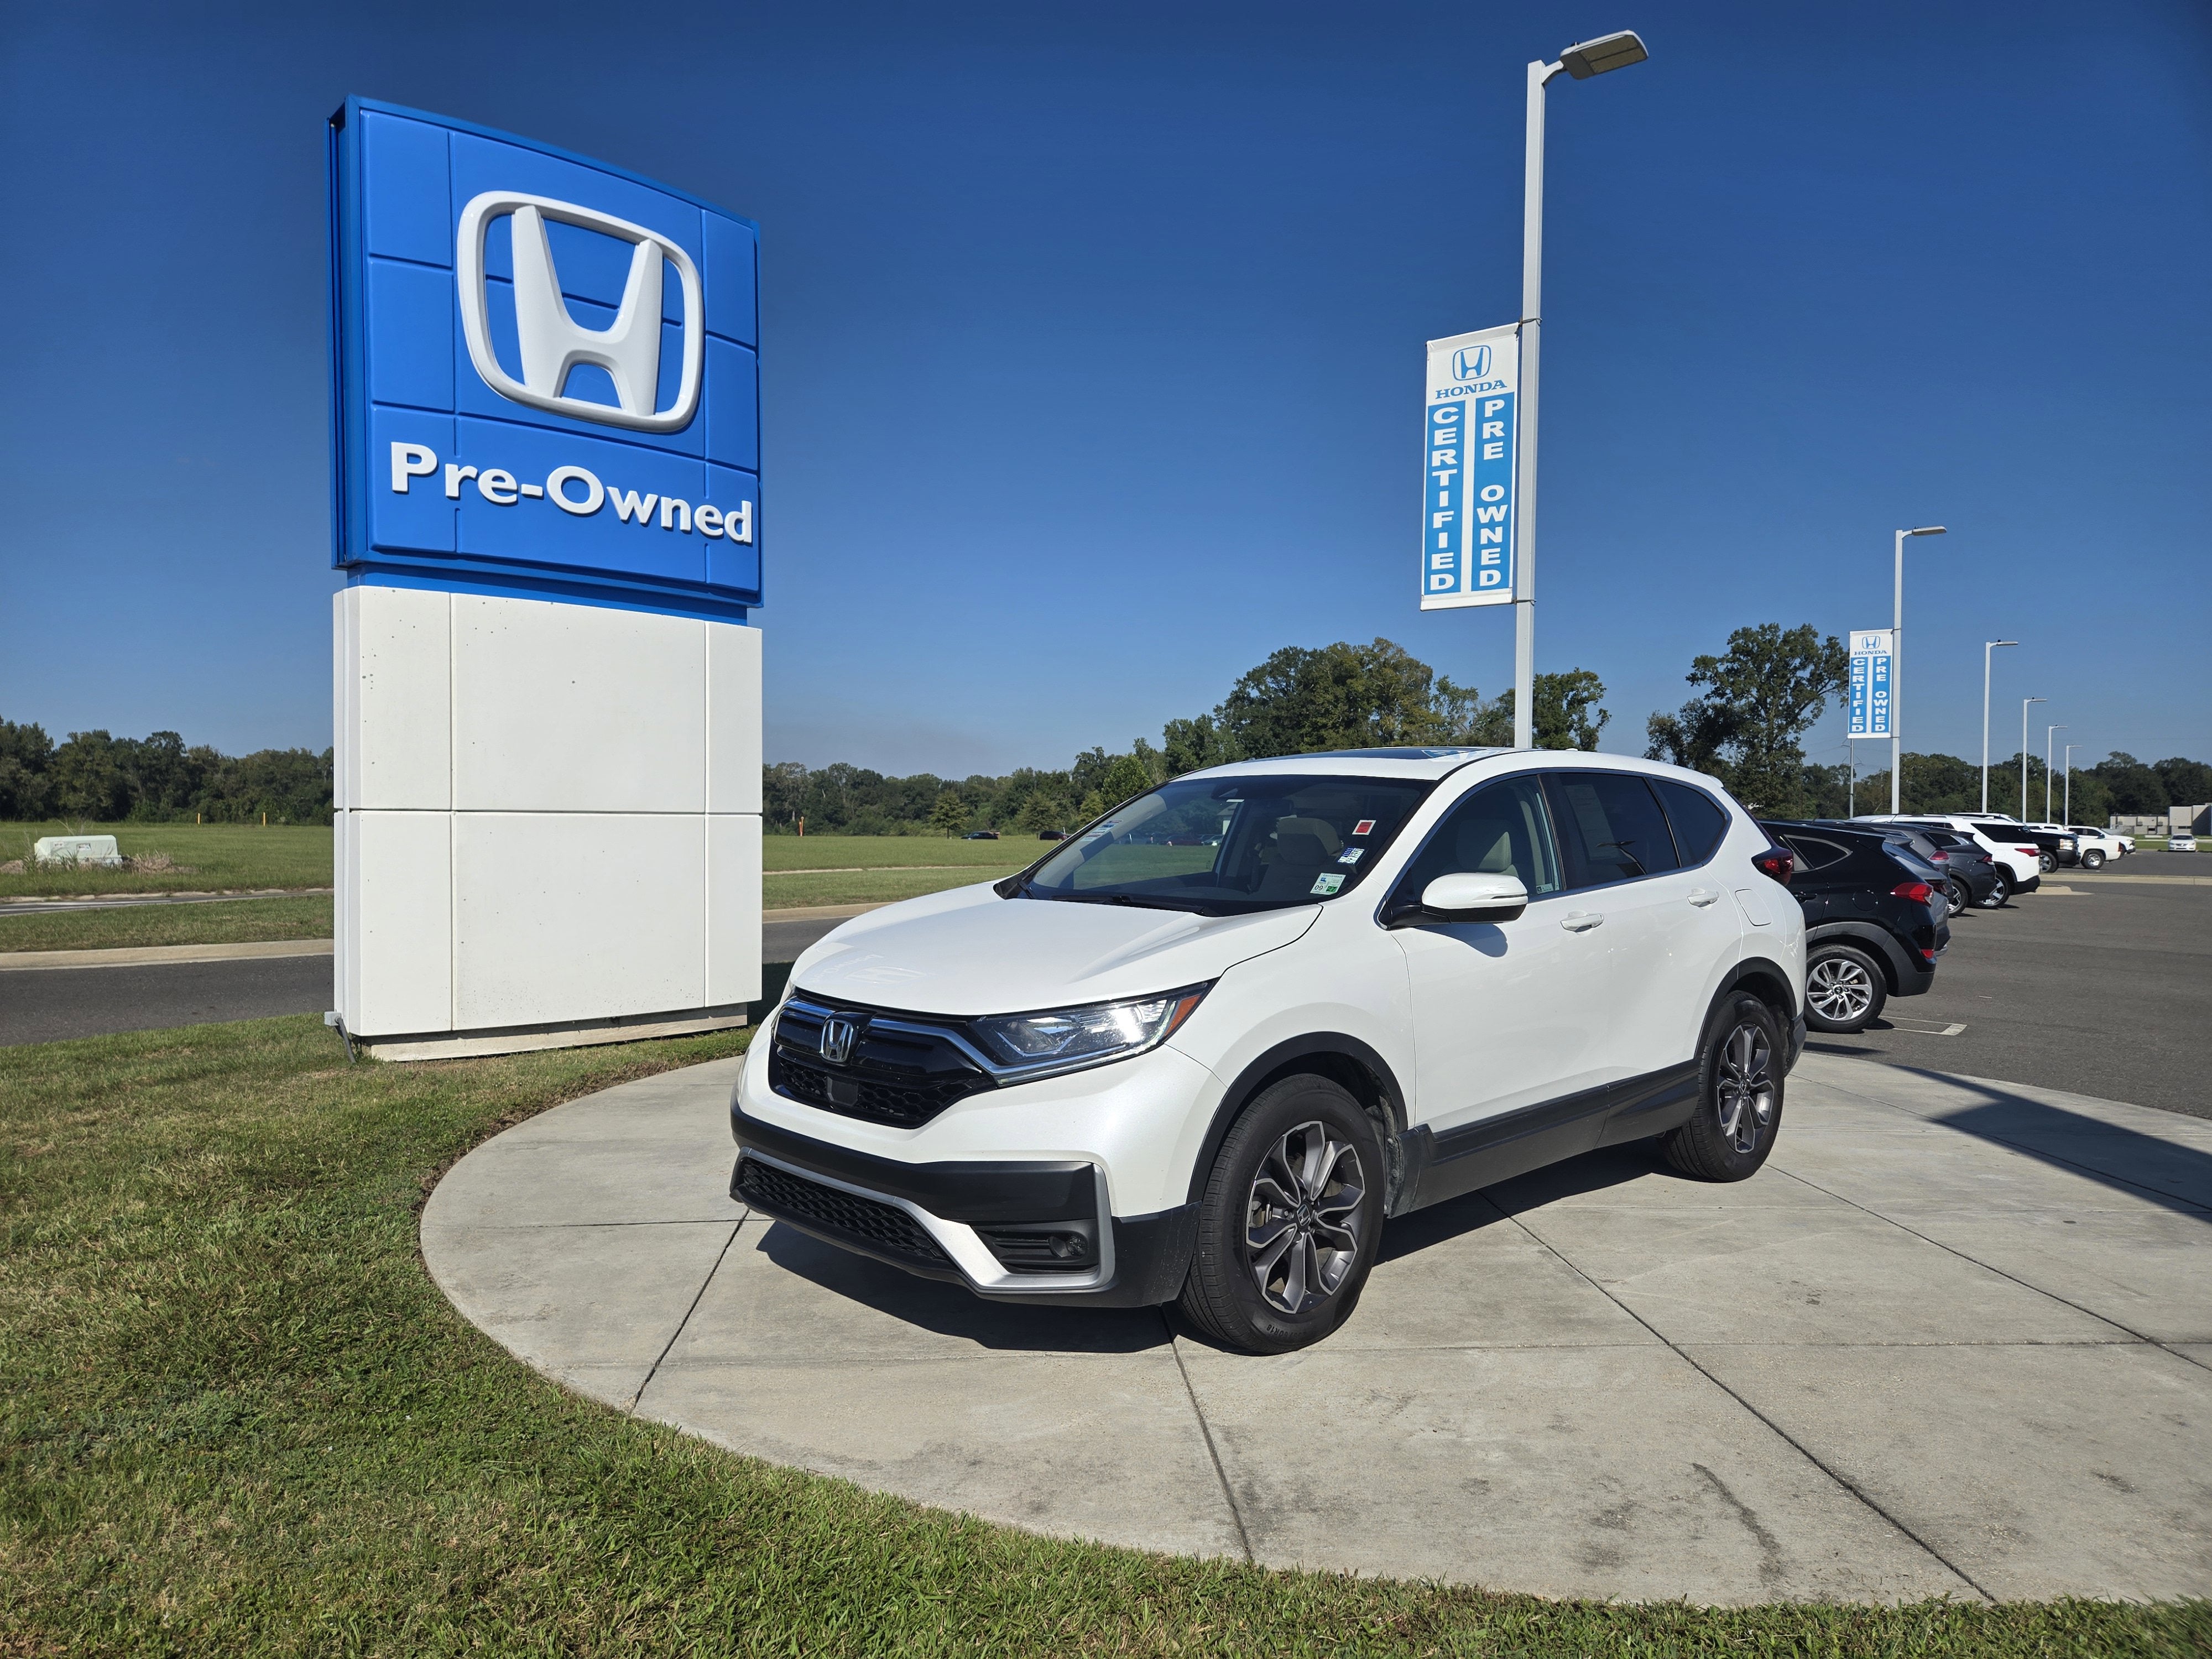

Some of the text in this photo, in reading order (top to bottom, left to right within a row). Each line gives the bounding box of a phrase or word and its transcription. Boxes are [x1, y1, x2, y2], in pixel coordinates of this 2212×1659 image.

[1435, 379, 1507, 399] HONDA
[390, 441, 753, 544] Pre-Owned
[1430, 406, 1459, 591] CERTIFIED
[1476, 399, 1509, 587] PRE OWNED
[1851, 658, 1866, 732] CERTIFIED
[1873, 658, 1888, 732] PRE OWNED
[1266, 1324, 1306, 1337] 5/60R18
